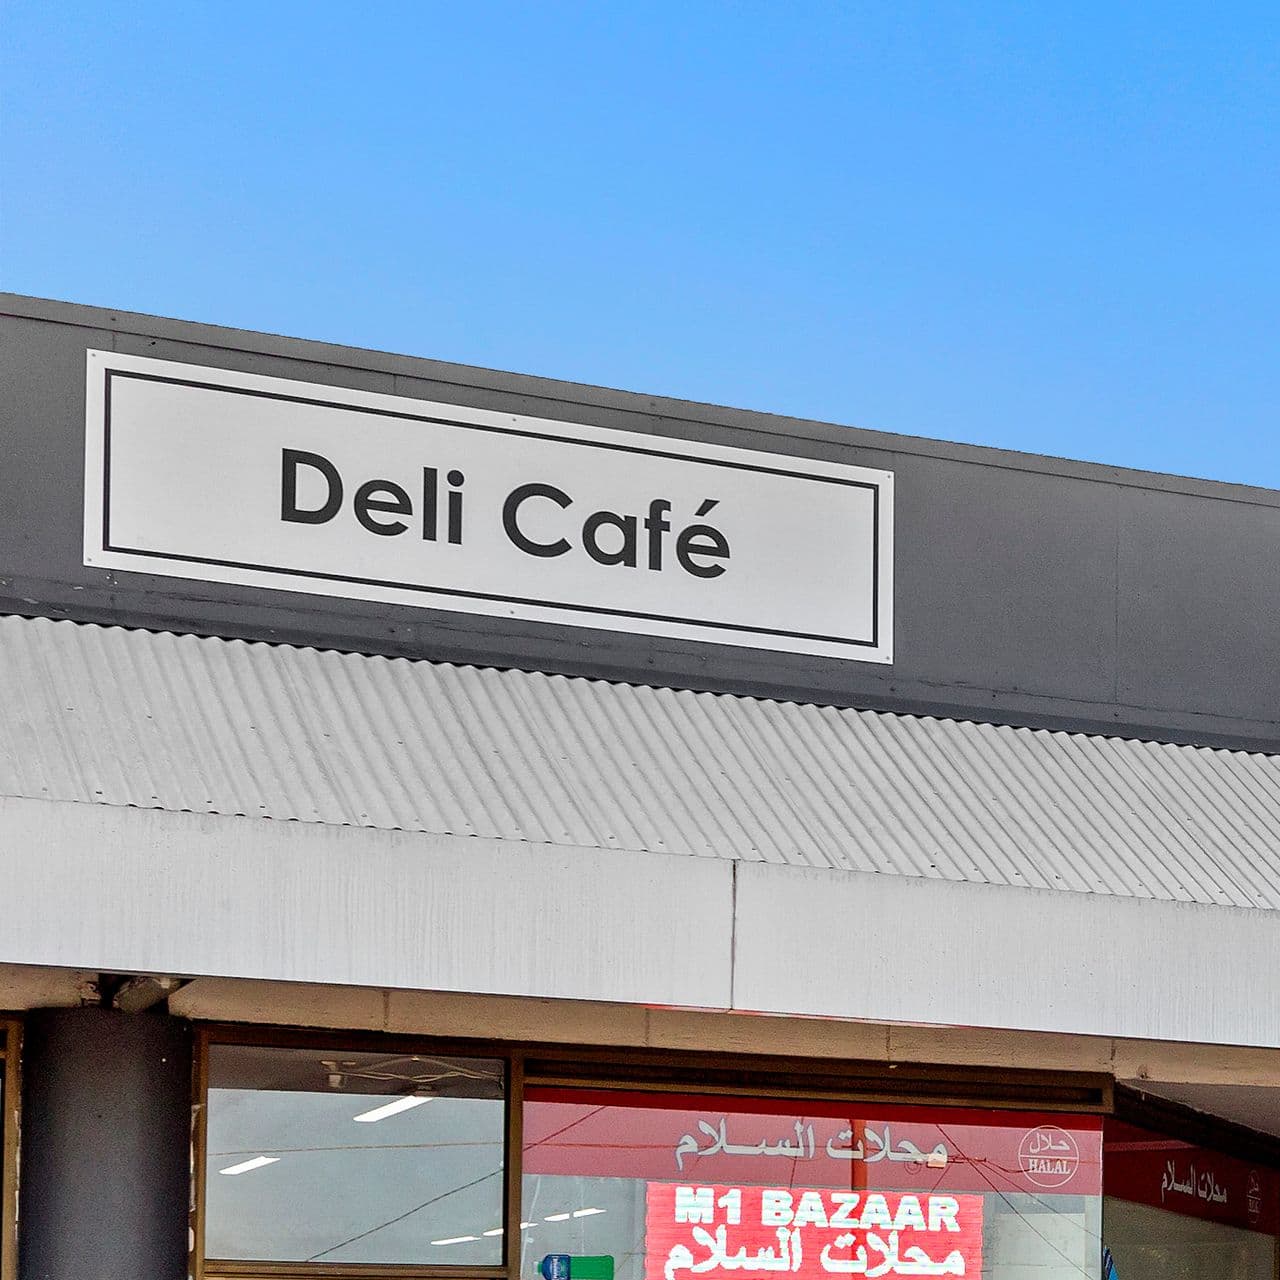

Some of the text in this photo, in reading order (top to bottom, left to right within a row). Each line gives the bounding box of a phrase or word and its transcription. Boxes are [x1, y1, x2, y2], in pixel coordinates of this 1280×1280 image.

[281, 448, 731, 579] Deli Café
[675, 1117, 948, 1171] محلات السلام
[1028, 1158, 1071, 1176] HALAL
[674, 1187, 960, 1233] M1 BAZAAR
[820, 1229, 965, 1278] محلات
